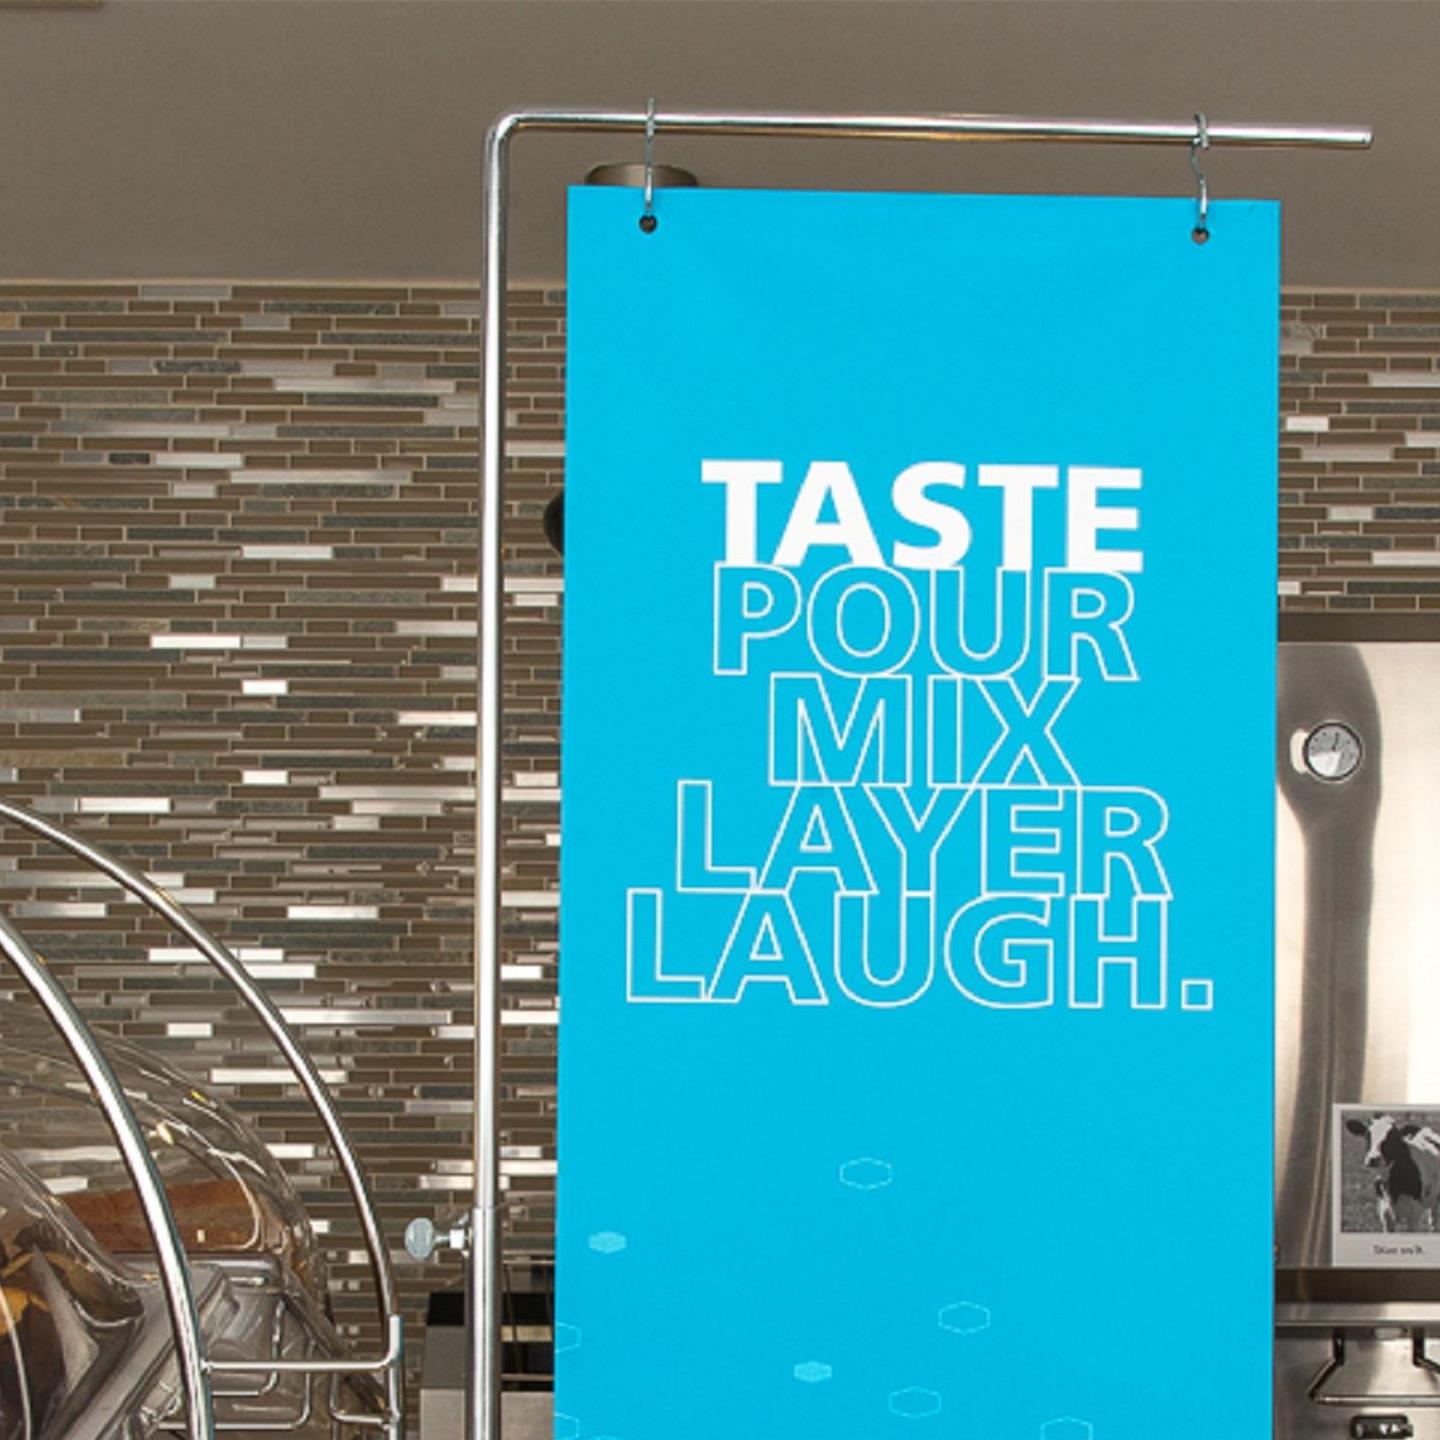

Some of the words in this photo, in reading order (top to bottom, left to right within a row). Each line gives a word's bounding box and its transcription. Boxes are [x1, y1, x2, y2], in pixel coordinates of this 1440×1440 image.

[701, 459, 1143, 573] TASTE
[713, 561, 1140, 681] POUR
[769, 672, 1082, 788] MIX
[677, 779, 1173, 900] LAYER
[626, 888, 1213, 1010] LAUGH.
